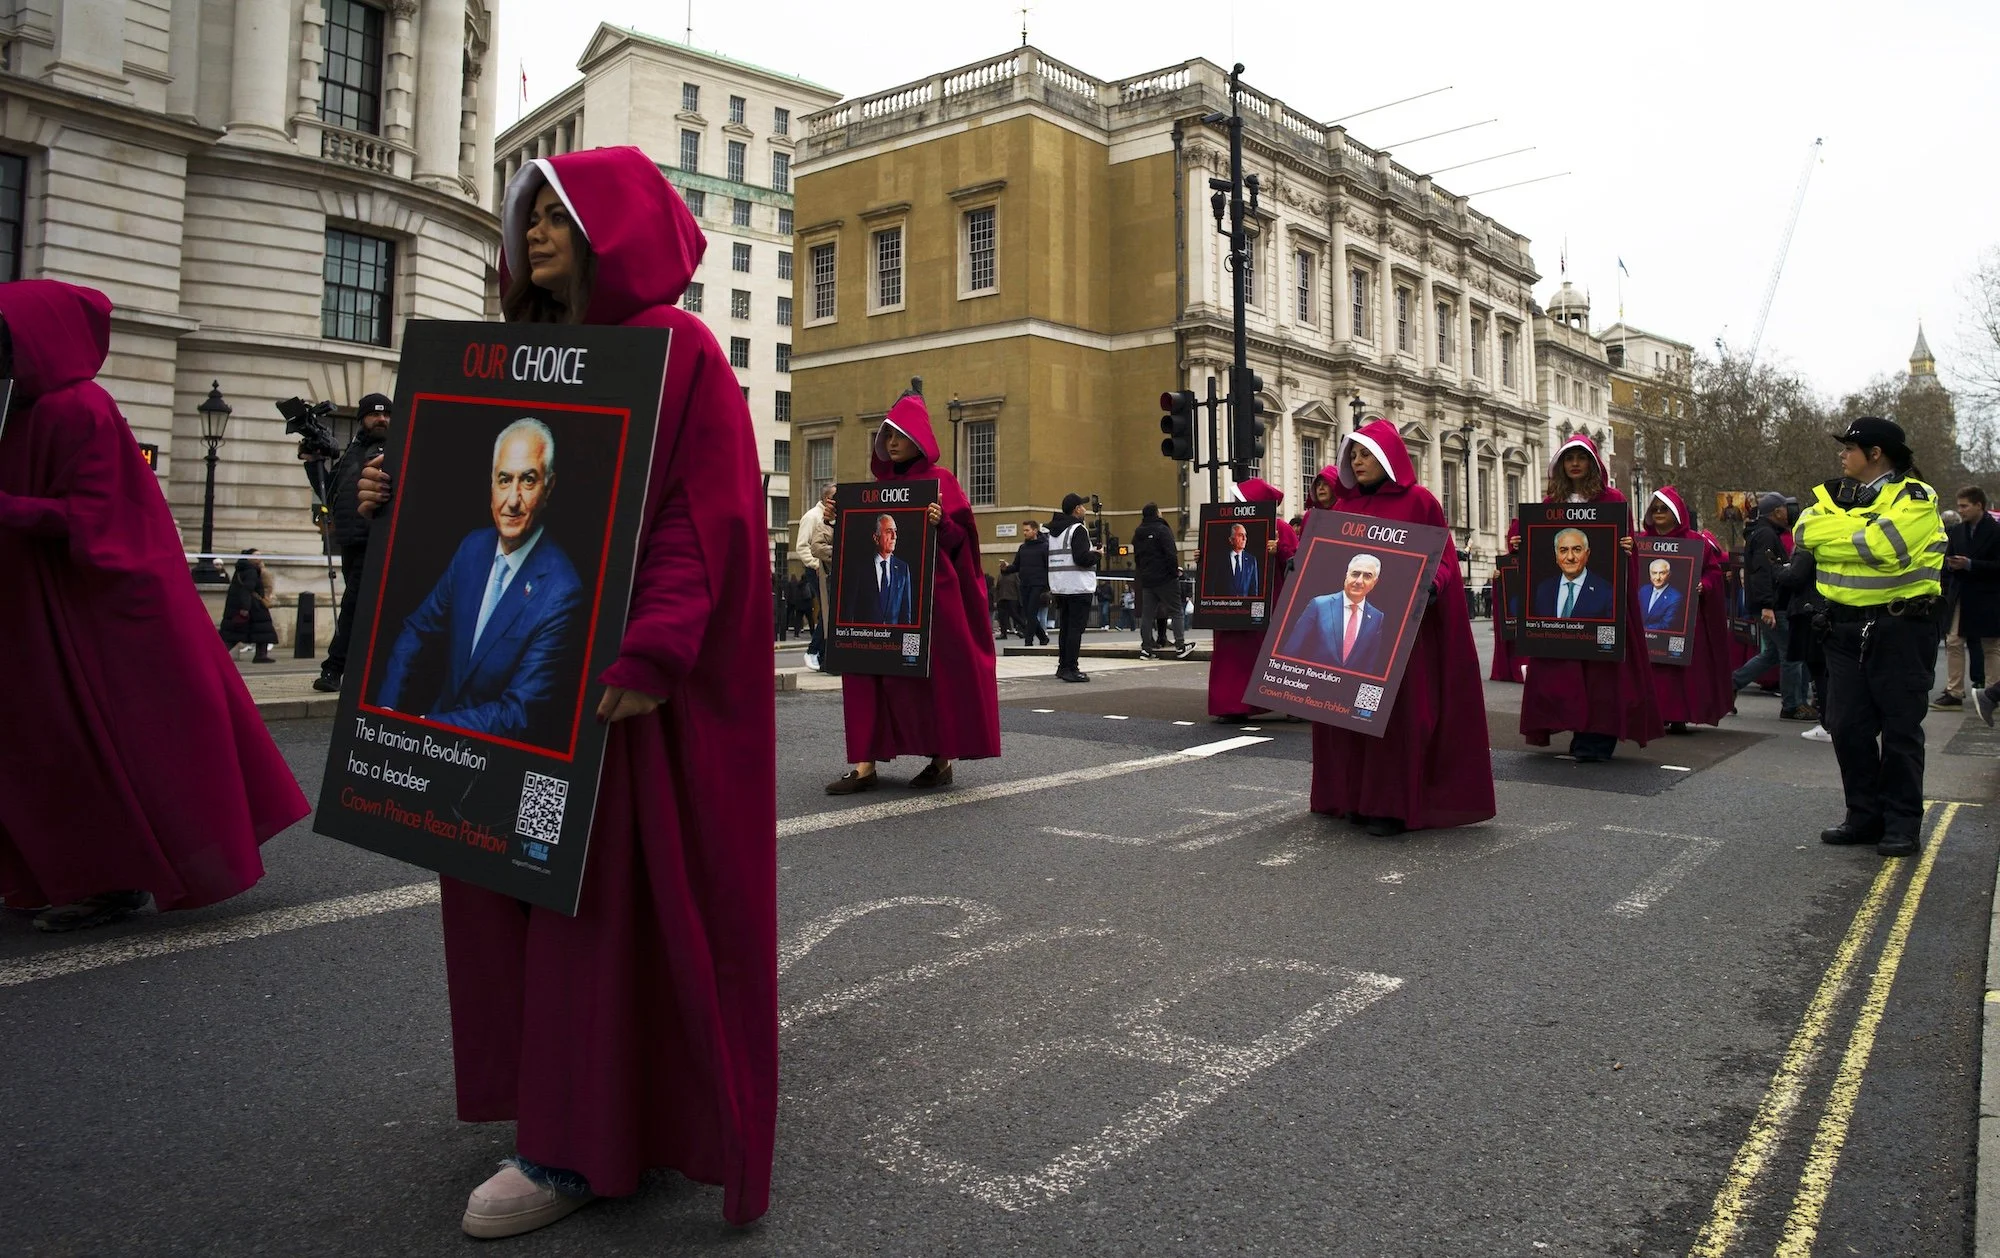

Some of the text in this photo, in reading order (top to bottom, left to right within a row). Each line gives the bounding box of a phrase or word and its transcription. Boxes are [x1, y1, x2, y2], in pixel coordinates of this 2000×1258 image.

[463, 342, 588, 385] OUR CHOICE
[861, 488, 910, 503] OUR CHOICE
[1220, 506, 1256, 517] OUR CHOICE
[1546, 508, 1597, 520] OUR CHOICE
[1341, 521, 1408, 545] OUR CHOICE
[1653, 541, 1679, 552] CHOICE
[836, 628, 891, 638] Iran's Transition Leader
[1541, 621, 1565, 629] Transition
[1566, 622, 1585, 630] Leader
[1263, 671, 1276, 683] has
[1268, 659, 1341, 683] The Iranian Revolution
[1258, 685, 1282, 698] Crown
[1282, 690, 1304, 704] Prince
[1304, 695, 1324, 709] Reza
[1323, 702, 1351, 714] Pahlavi
[356, 717, 487, 771] The Iranian Revolution
[347, 750, 431, 793] has a leadeer
[341, 786, 381, 816] Crown
[384, 798, 422, 829] Prince
[423, 809, 457, 839] Reza
[459, 819, 508, 854] Pahlavi
